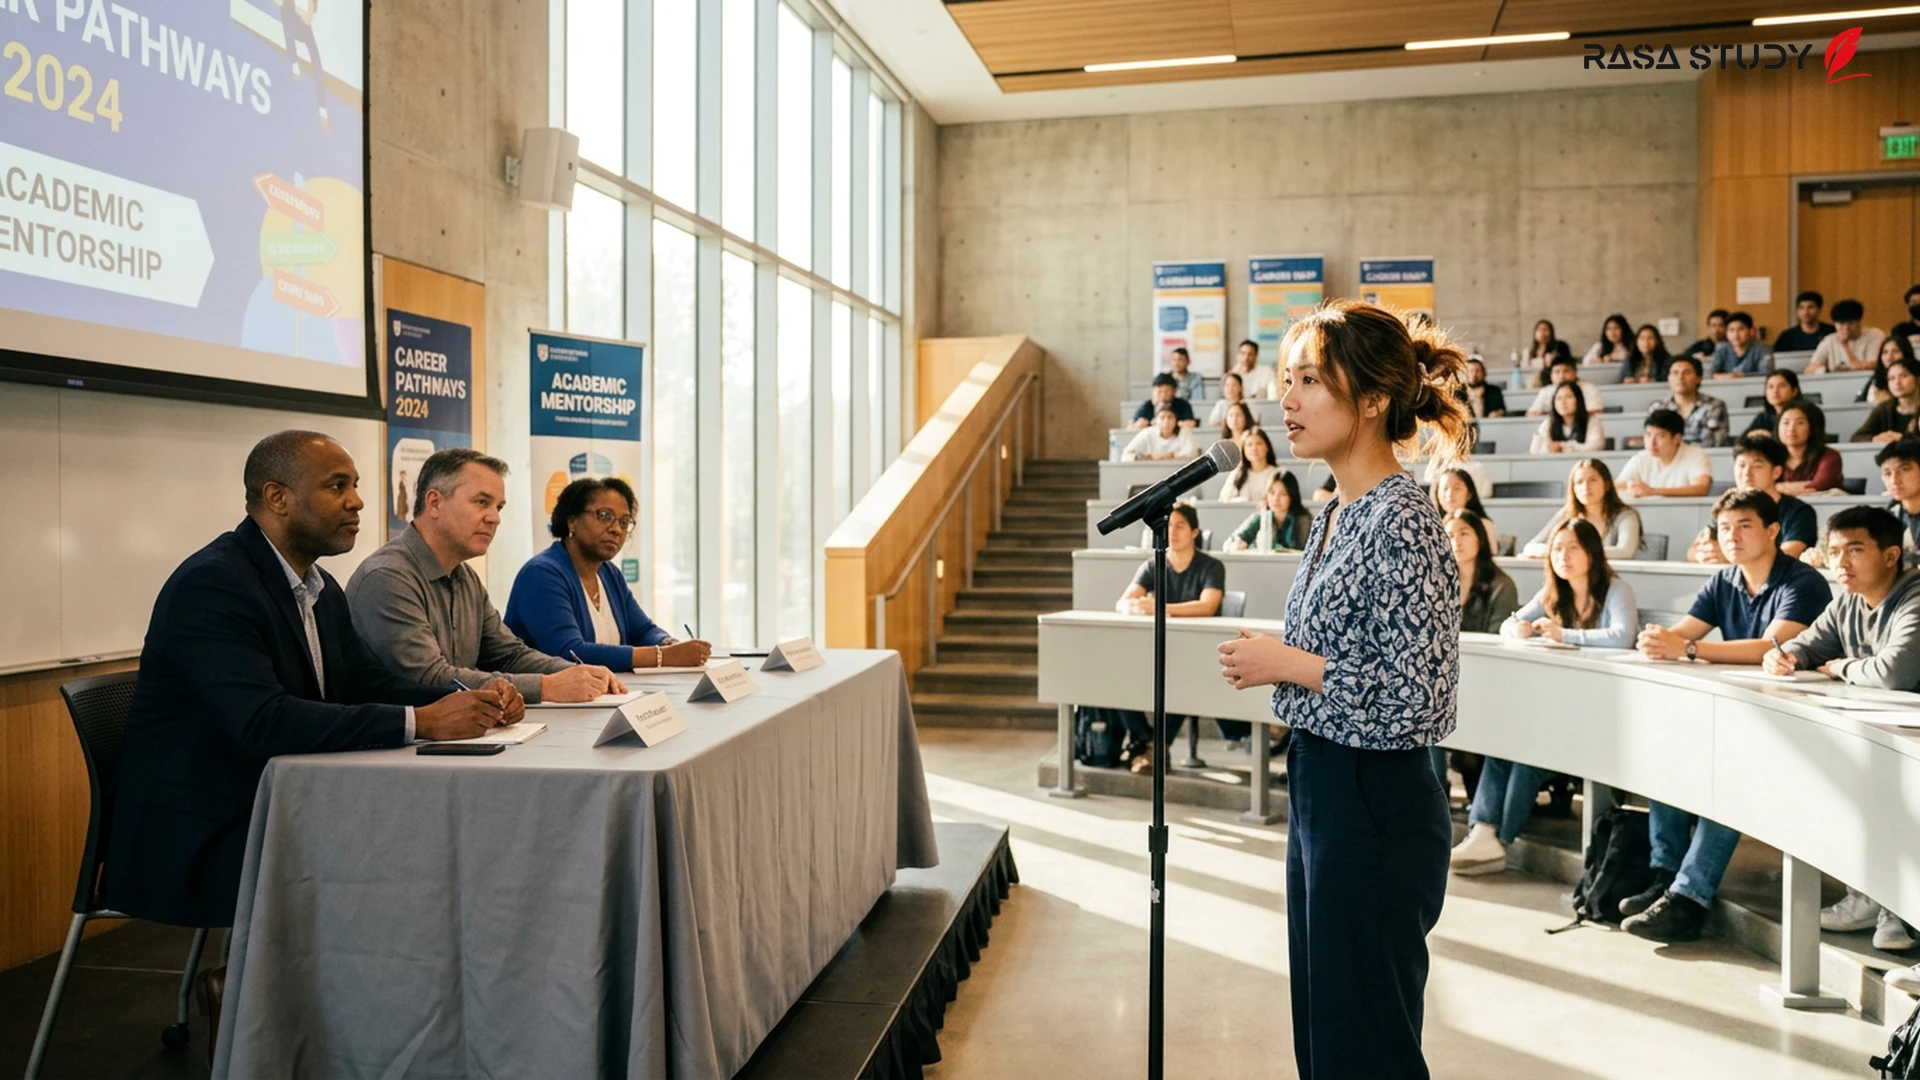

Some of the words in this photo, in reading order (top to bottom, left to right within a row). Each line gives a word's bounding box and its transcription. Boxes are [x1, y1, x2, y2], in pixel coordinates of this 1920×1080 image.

[56, 0, 272, 115] PATHWAYS
[3, 41, 123, 132] 2024
[394, 346, 448, 373] CAREER
[395, 395, 429, 419] 2024
[540, 391, 636, 415] MENTORSHIP
